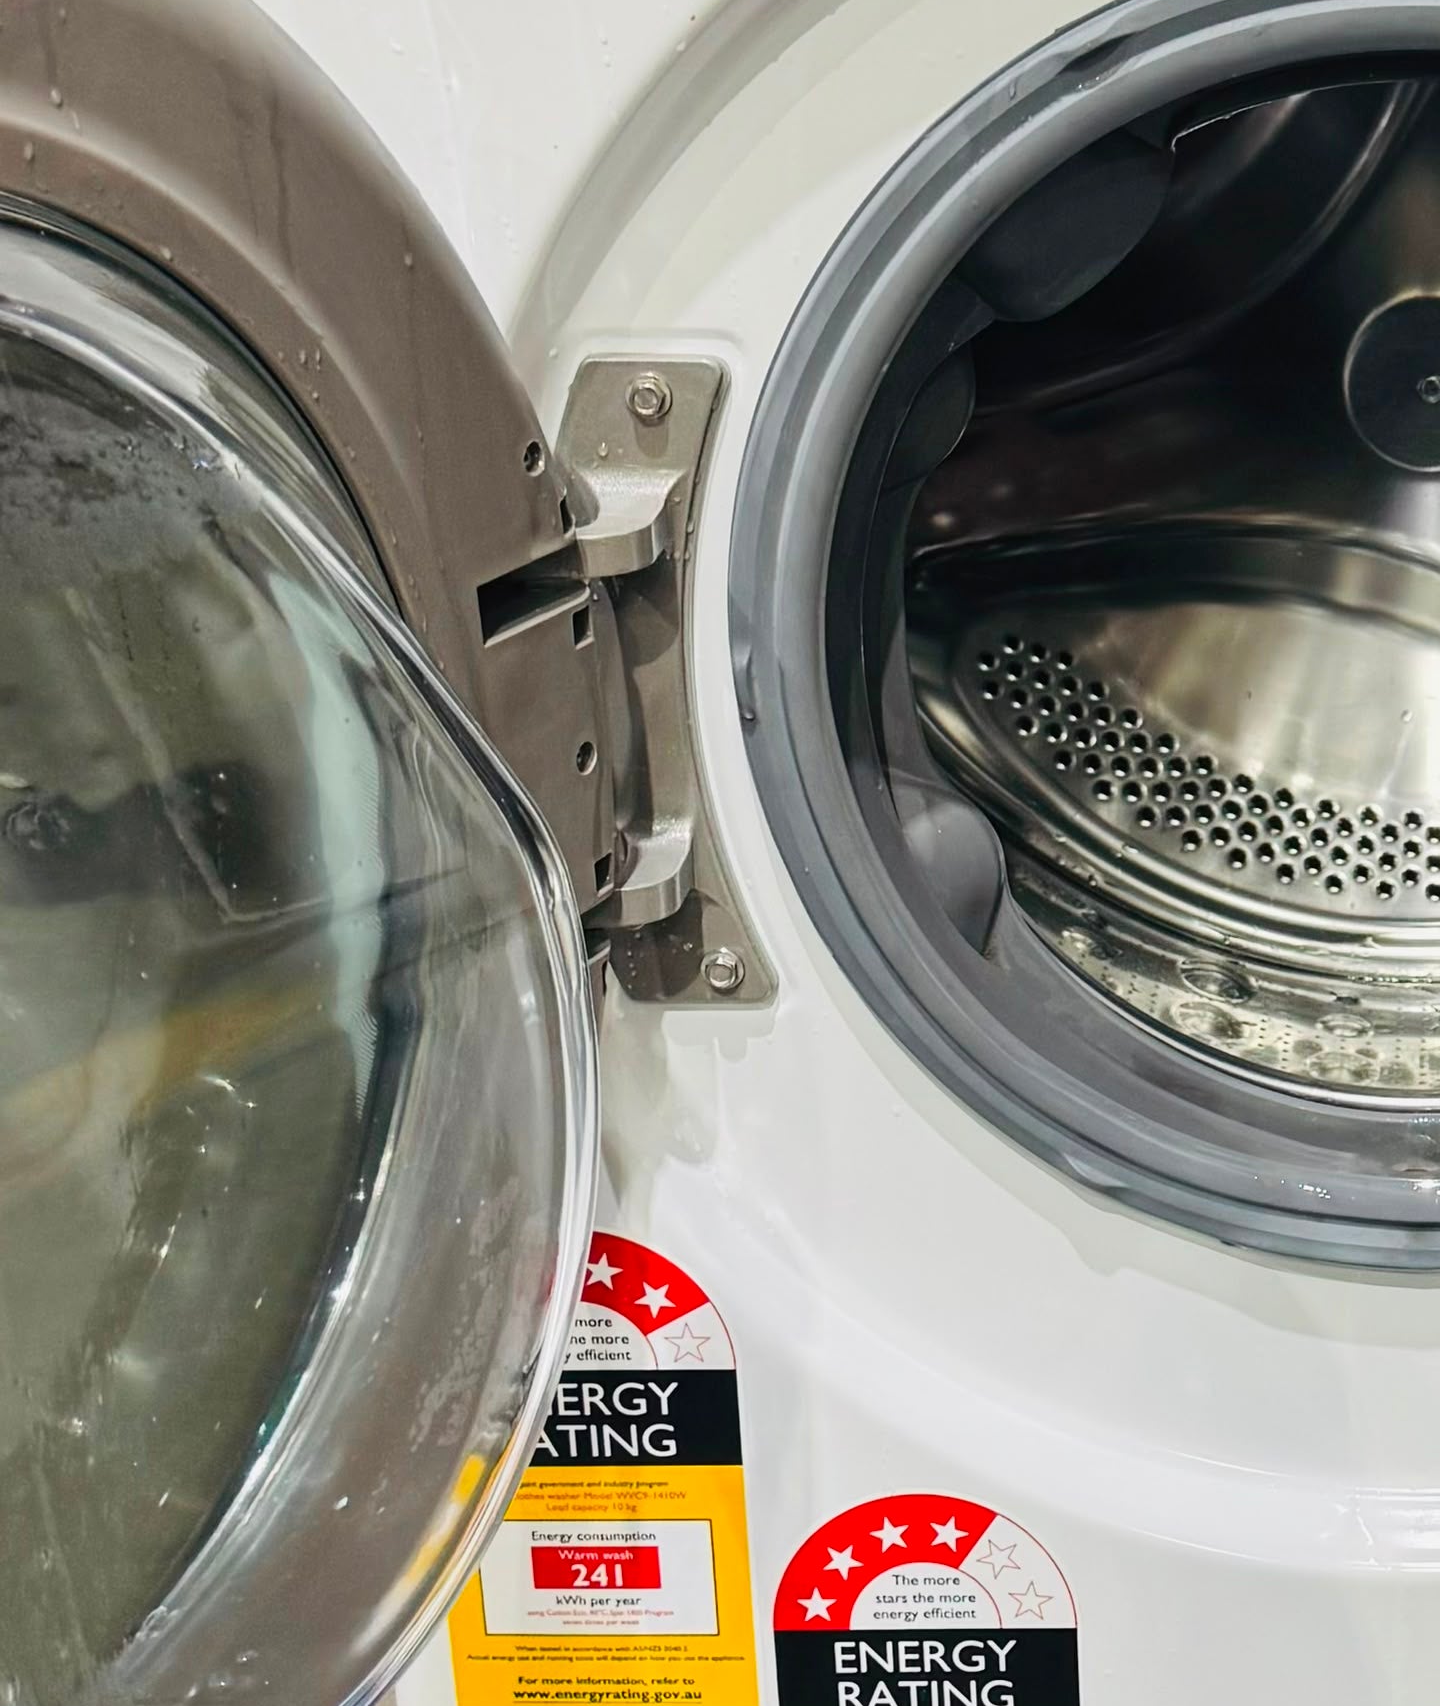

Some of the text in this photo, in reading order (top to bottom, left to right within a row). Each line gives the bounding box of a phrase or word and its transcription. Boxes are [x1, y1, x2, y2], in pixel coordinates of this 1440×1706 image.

[574, 1318, 613, 1328] more
[592, 1335, 629, 1344] more
[577, 1349, 632, 1361] efficient
[553, 1382, 678, 1417] ERGY
[536, 1423, 677, 1458] ATING
[531, 1530, 657, 1543] Energy consumption
[558, 1549, 633, 1560] Warm wash
[571, 1563, 624, 1587] 241
[892, 1574, 960, 1586] The more
[556, 1595, 642, 1608] kWh per year
[876, 1592, 976, 1603] stars the more
[873, 1608, 976, 1622] energy efficient
[834, 1639, 1017, 1674] ENERGY
[518, 1676, 537, 1685] For
[542, 1677, 573, 1685] more
[651, 1676, 678, 1685] refer
[683, 1676, 694, 1685] to
[513, 1688, 703, 1703] www.energyrating.gov.au
